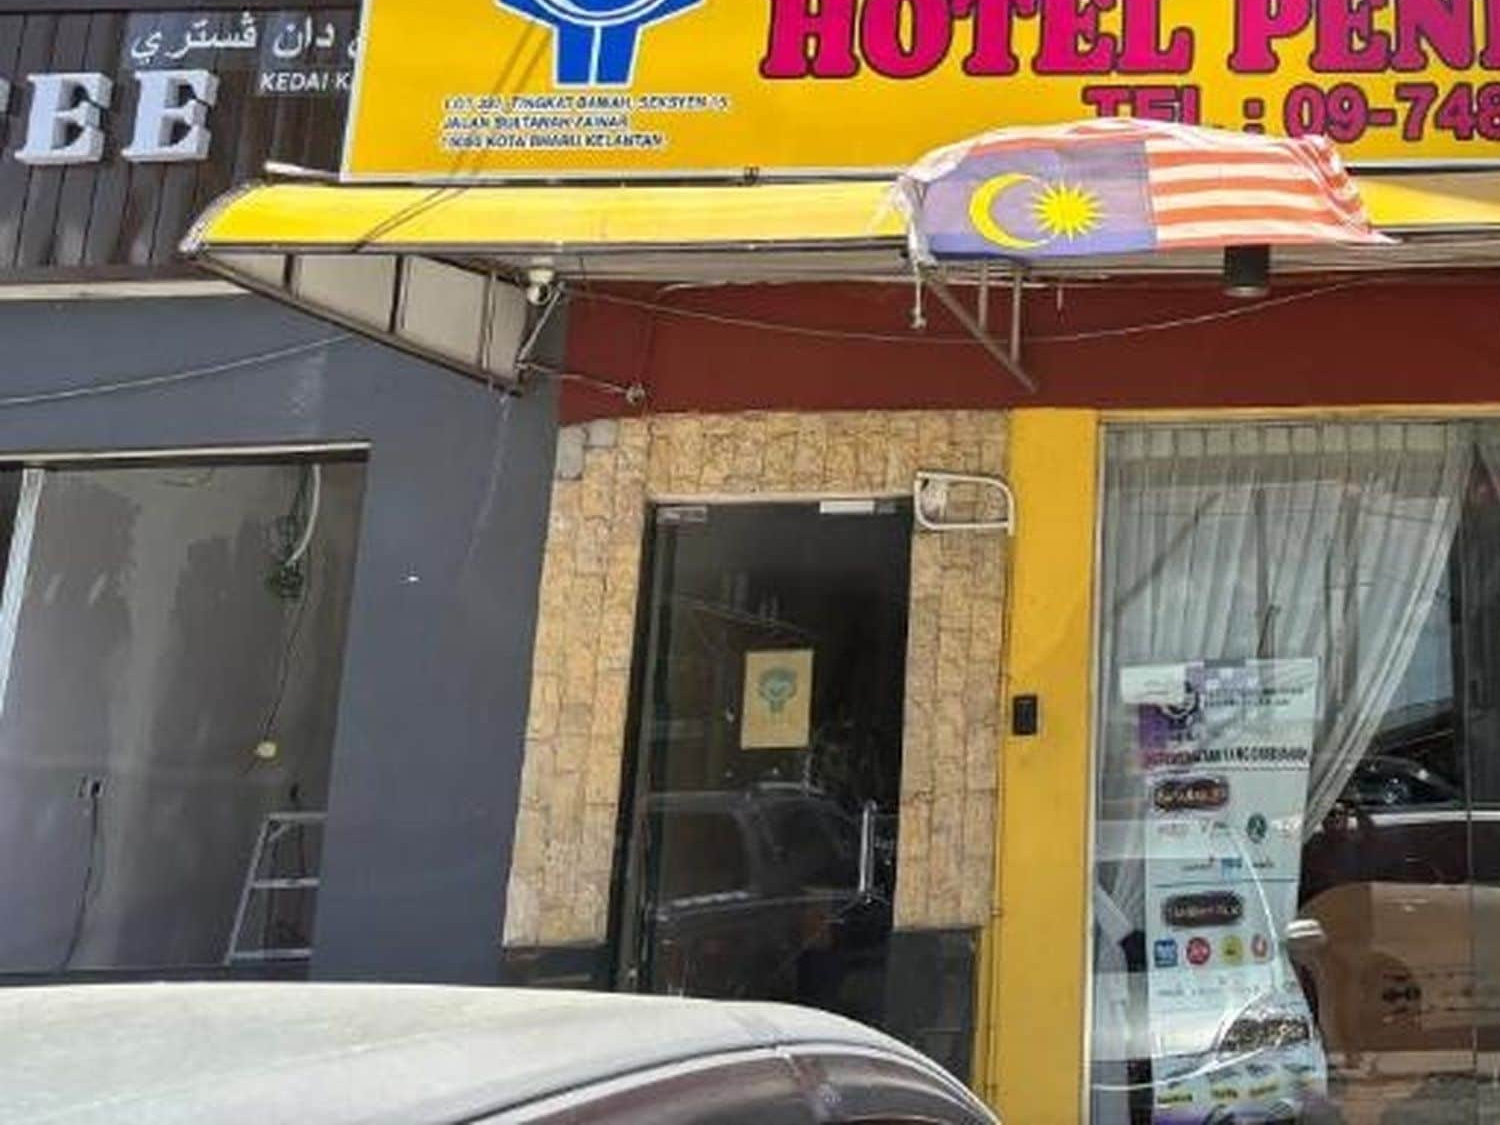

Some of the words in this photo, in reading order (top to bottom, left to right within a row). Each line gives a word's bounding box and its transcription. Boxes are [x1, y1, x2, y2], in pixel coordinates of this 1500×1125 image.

[273, 16, 335, 58] دان
[260, 72, 328, 92] KEDAI
[335, 72, 352, 91] K
[0, 70, 218, 165] EE
[486, 134, 526, 148] KOTA
